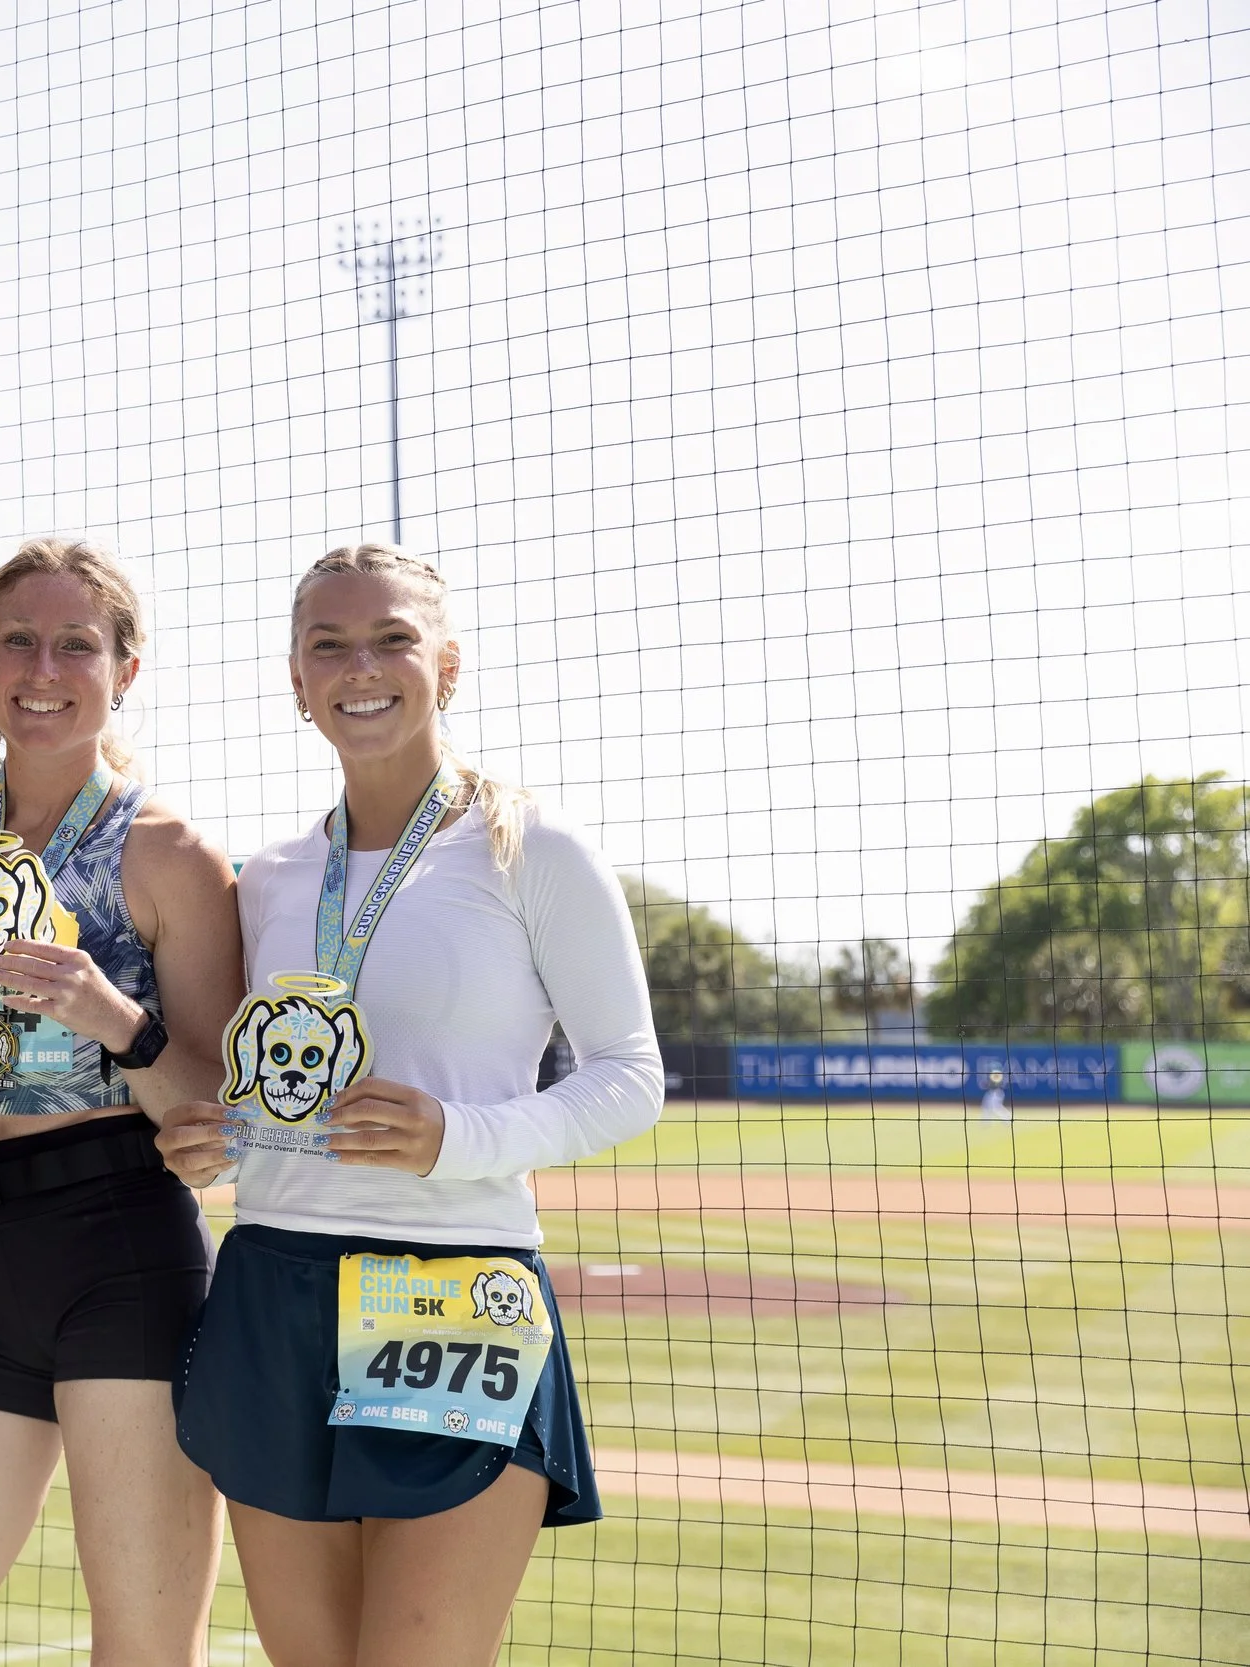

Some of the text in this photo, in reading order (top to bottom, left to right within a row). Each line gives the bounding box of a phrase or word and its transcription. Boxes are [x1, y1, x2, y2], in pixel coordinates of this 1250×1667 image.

[354, 789, 448, 937] RUN CHARLIE RUN 5K
[19, 1051, 70, 1063] NE BEER
[737, 1054, 809, 1087] THE
[236, 1125, 257, 1140] RUN
[260, 1127, 310, 1146] CHARLIE
[255, 1142, 272, 1151] Place
[274, 1144, 297, 1153] Overall
[300, 1148, 324, 1157] Female
[360, 1256, 410, 1276] RUN
[360, 1275, 462, 1298] CHARLIE
[360, 1295, 445, 1317] RUN 5K
[366, 1340, 520, 1401] 4975
[362, 1406, 428, 1423] ONE BEER
[476, 1418, 505, 1434] ONE
